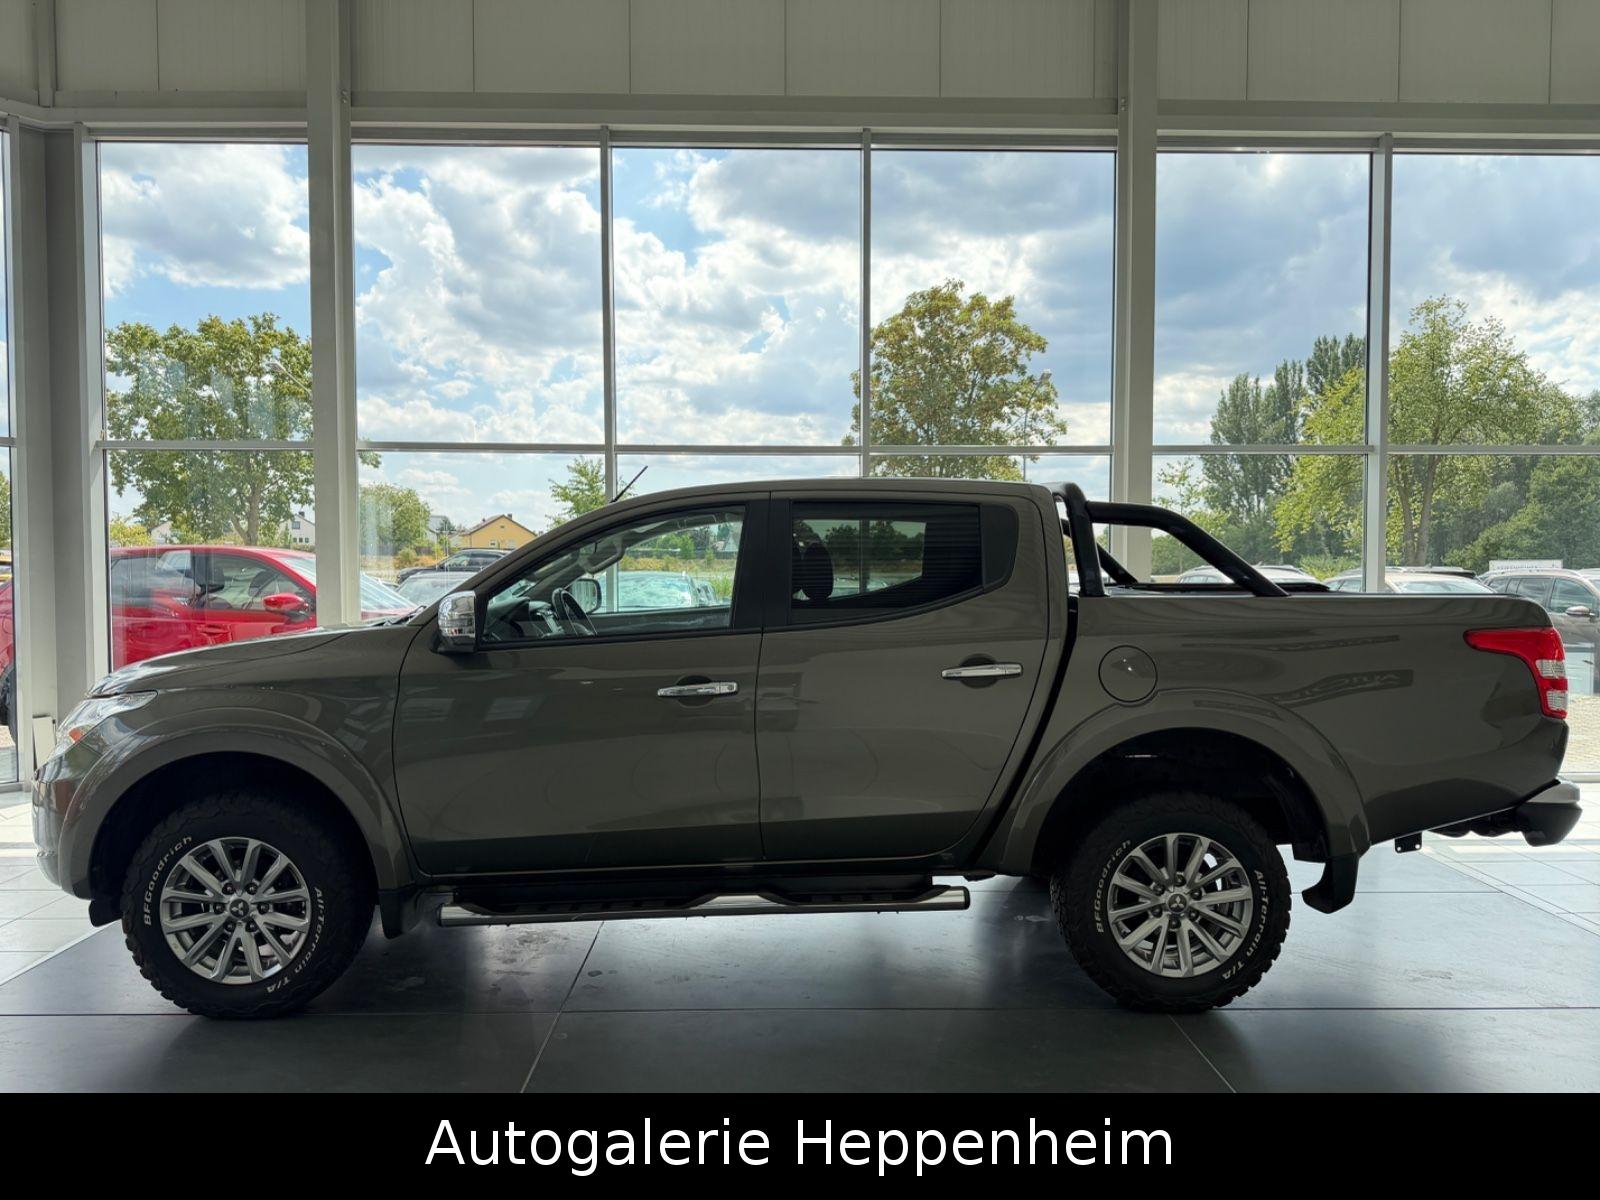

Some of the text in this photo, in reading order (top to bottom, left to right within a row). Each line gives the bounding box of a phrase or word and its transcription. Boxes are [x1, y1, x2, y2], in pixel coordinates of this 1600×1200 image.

[143, 836, 193, 926] BFGoodrich
[1093, 840, 1131, 933] BFGoodrich
[1221, 869, 1269, 981] All-Terrain T/A
[266, 886, 326, 994] All-Terrain T/A
